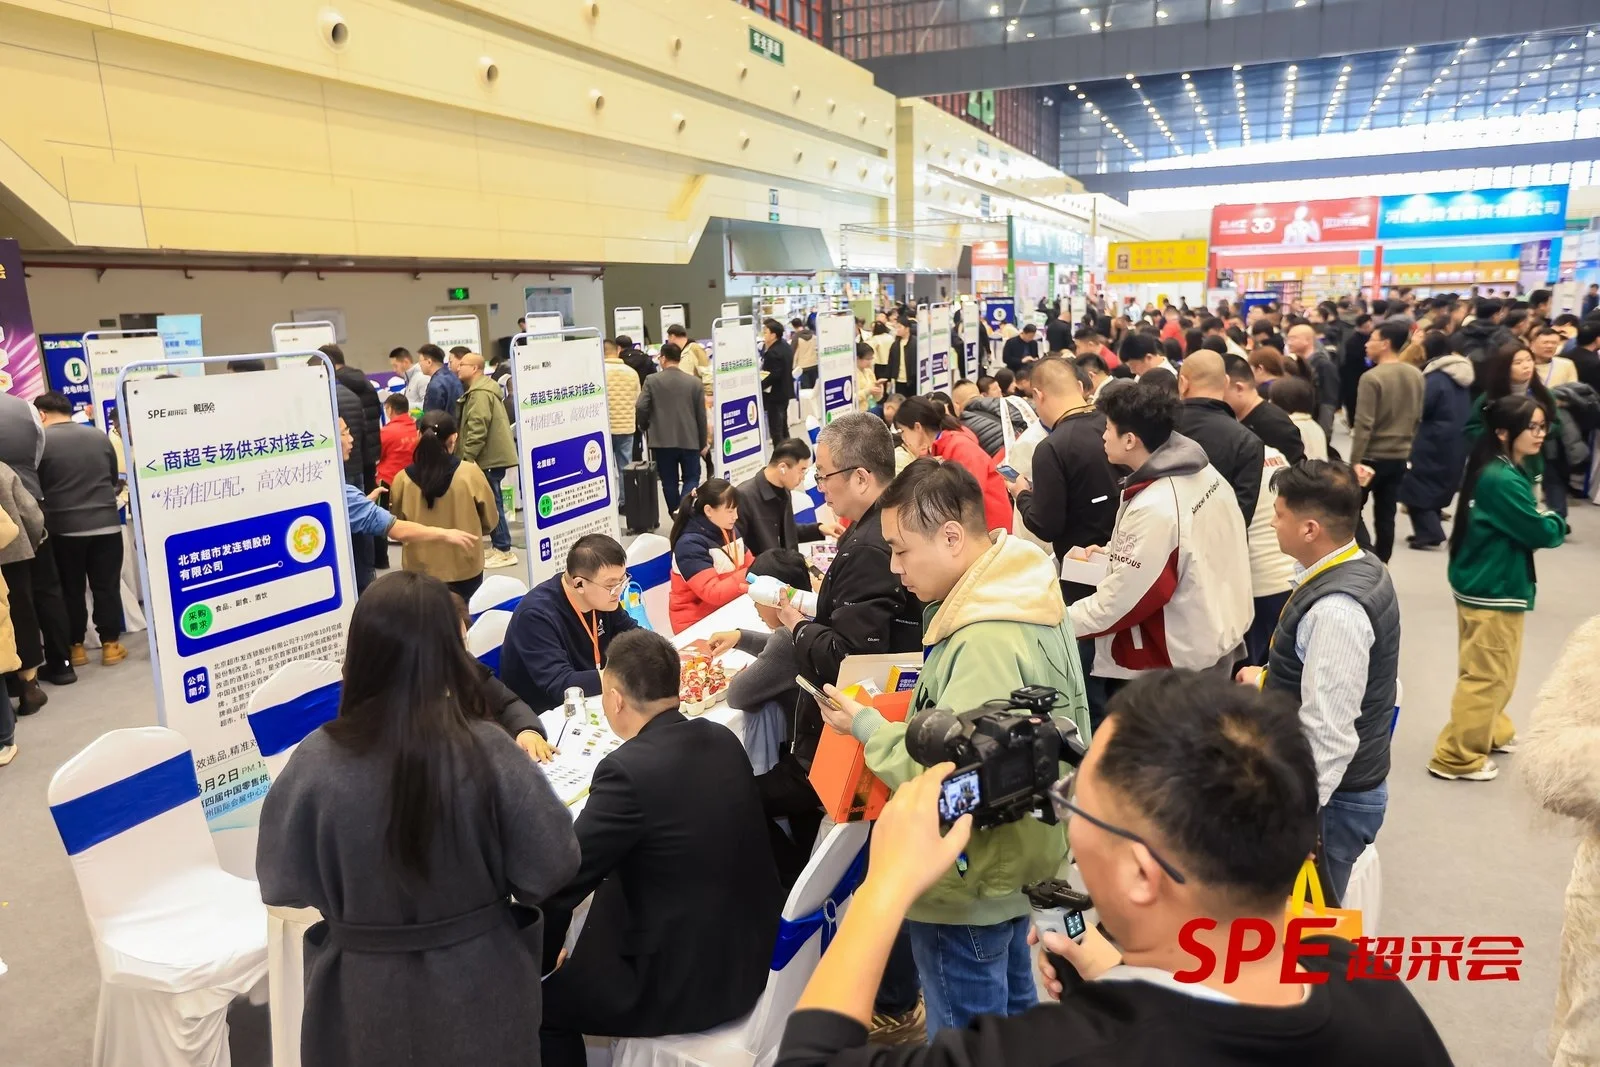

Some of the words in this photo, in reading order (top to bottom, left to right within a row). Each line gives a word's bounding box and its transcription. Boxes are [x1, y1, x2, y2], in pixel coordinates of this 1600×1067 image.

[147, 408, 167, 420] SPE
[163, 430, 315, 472] 商超专场供采对接会
[178, 534, 272, 566] 北京超市发连锁股份
[179, 562, 223, 581] 有限公司
[189, 609, 207, 621] 采购
[190, 620, 208, 632] 需求
[188, 673, 205, 686] 公司
[189, 684, 206, 697] 简介
[201, 773, 271, 808] 四届中国零售供
